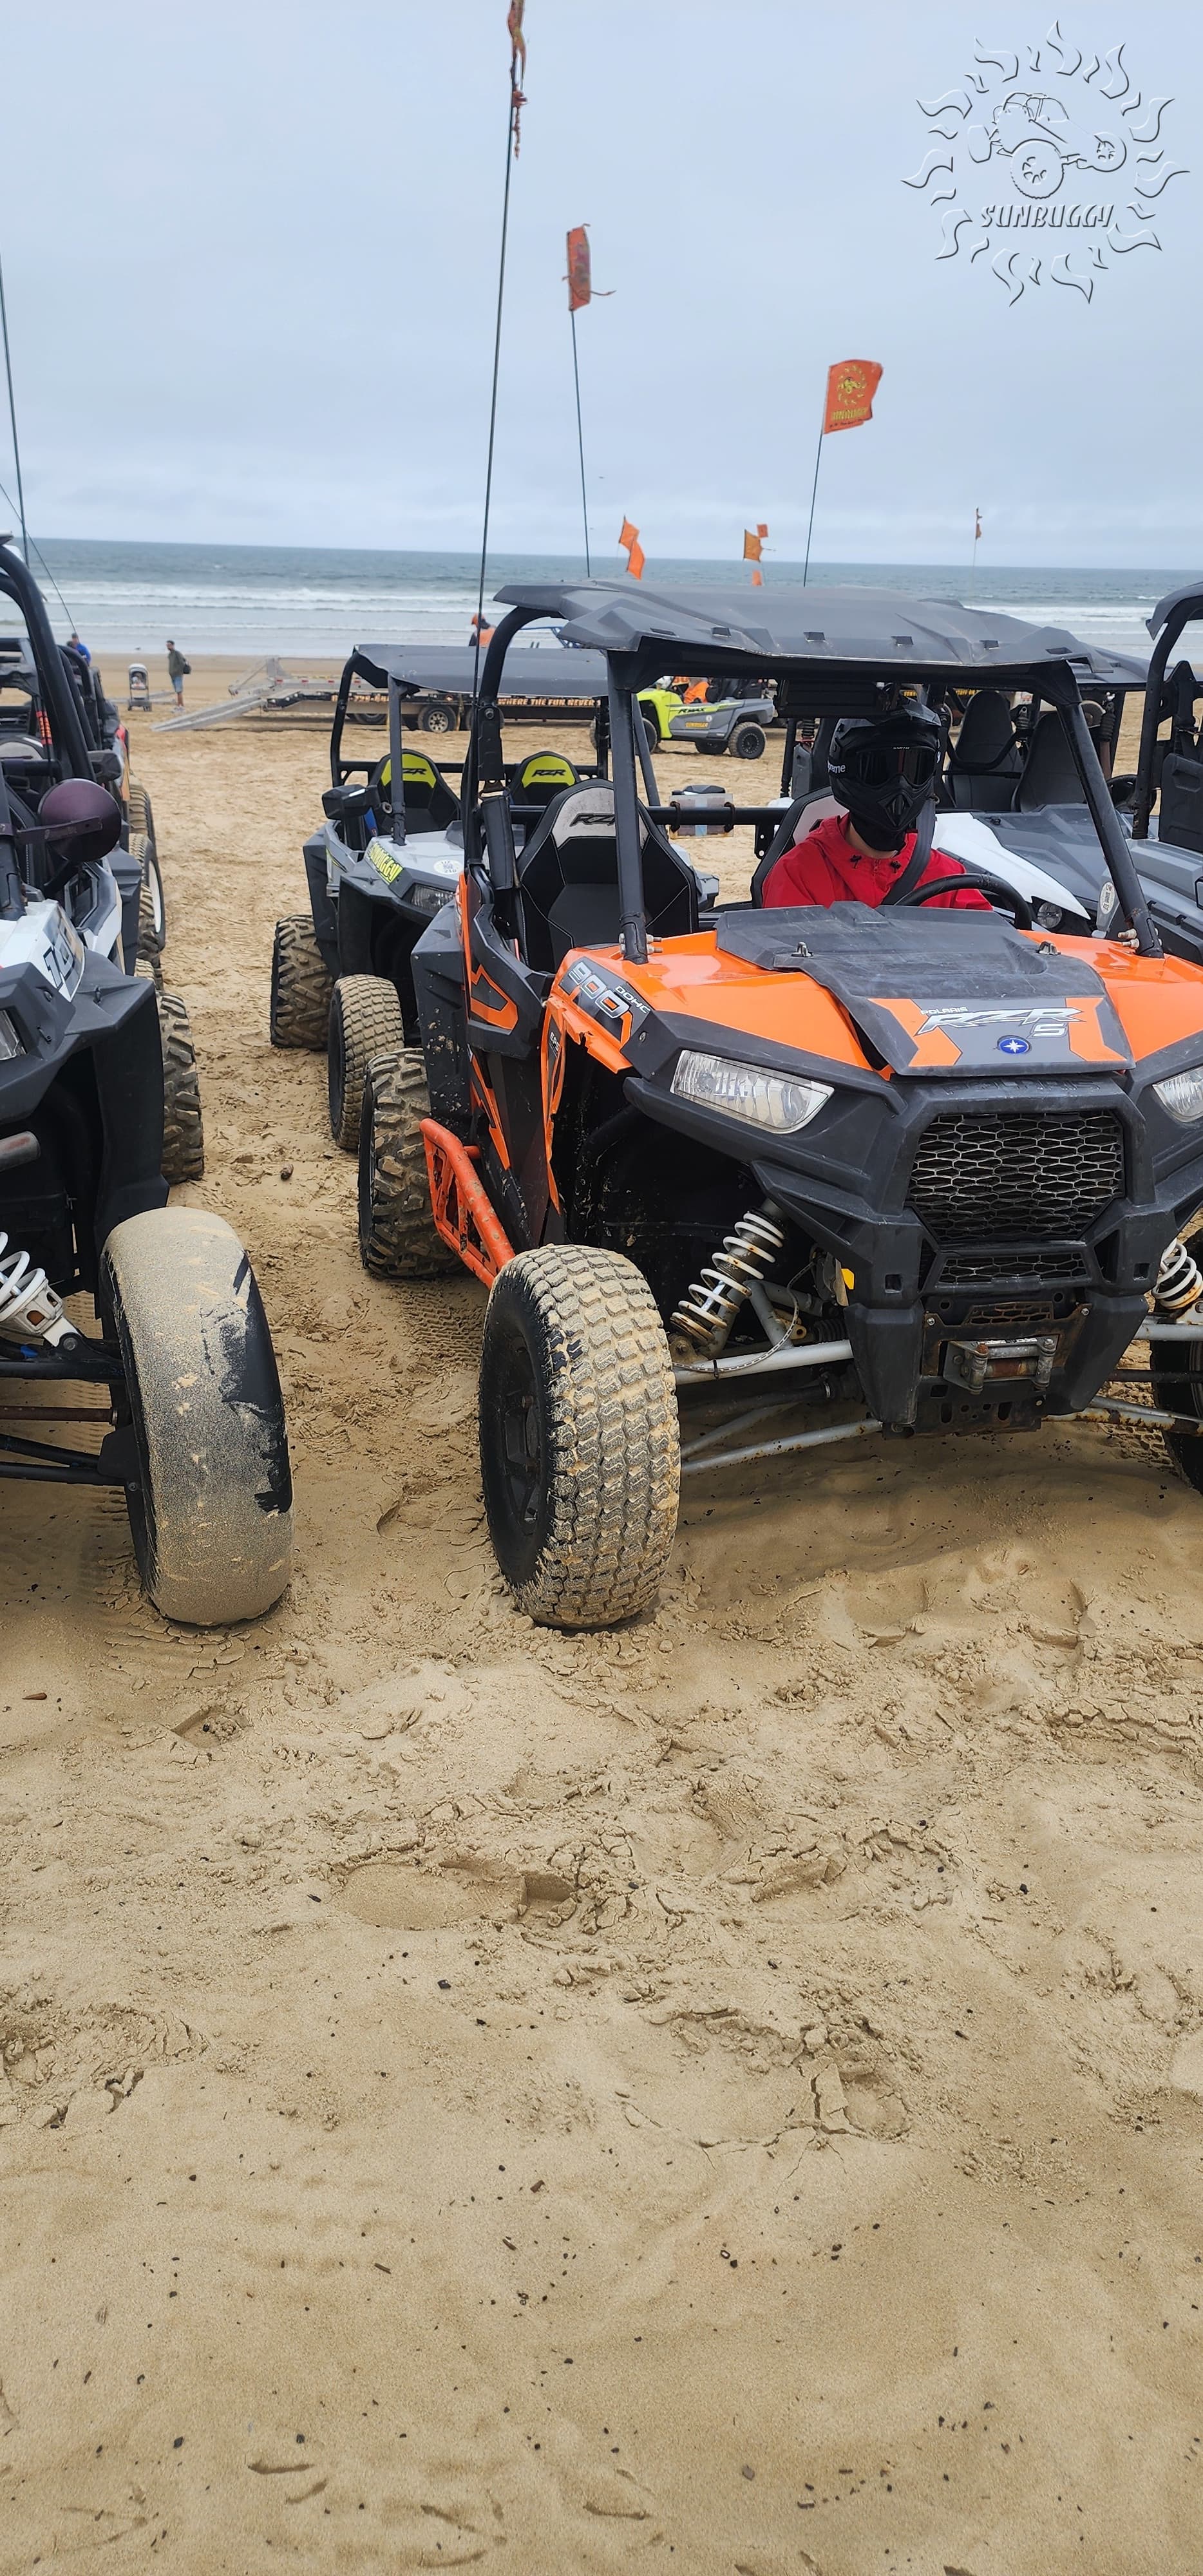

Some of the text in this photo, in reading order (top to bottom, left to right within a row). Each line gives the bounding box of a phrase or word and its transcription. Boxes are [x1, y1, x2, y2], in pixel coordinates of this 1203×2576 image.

[403, 768, 427, 776] ZR
[531, 769, 567, 777] RZR
[568, 961, 630, 1019] 900
[614, 985, 651, 1014] DOHC
[920, 1006, 969, 1016] POLARIS
[914, 1007, 1085, 1036] RZR
[1032, 1023, 1065, 1037] S
[550, 1032, 560, 1052] EPS
